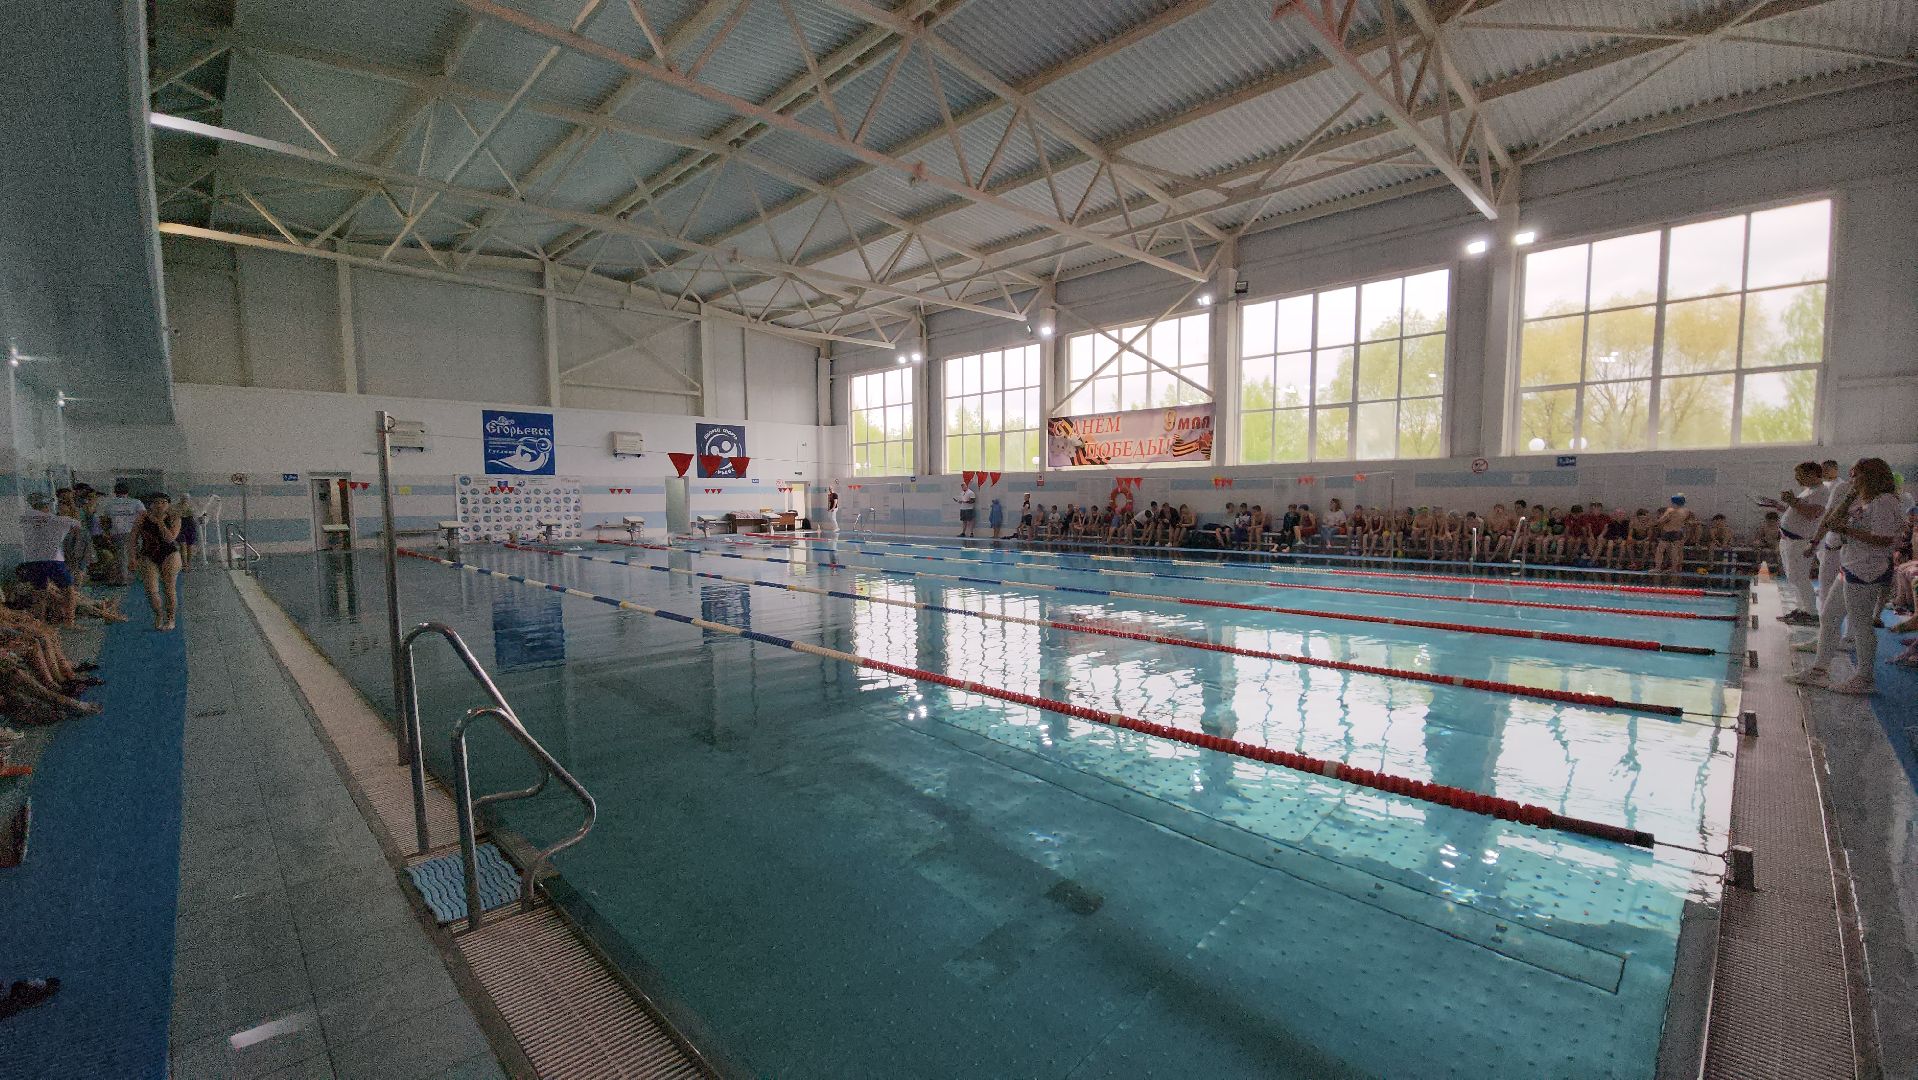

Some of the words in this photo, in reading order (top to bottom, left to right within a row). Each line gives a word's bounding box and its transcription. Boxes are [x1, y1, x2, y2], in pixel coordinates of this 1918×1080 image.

[486, 421, 551, 437] Егорьевск
[1164, 409, 1177, 432] 9
[1086, 437, 1169, 459] ПОБЕДЫ!
